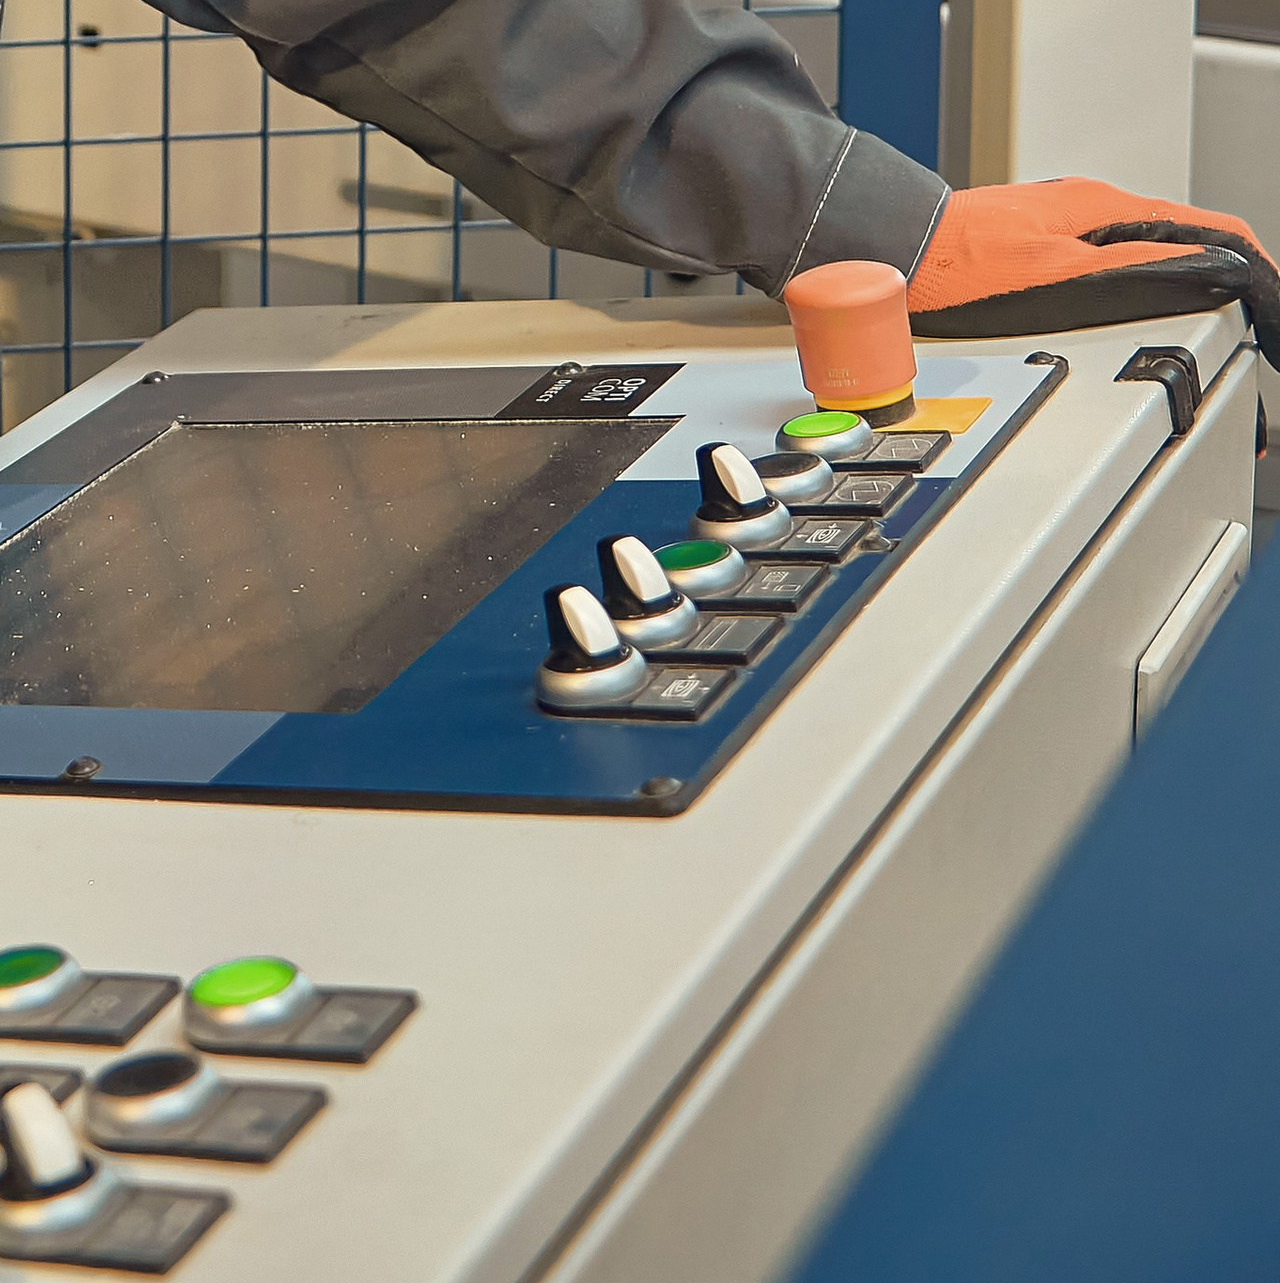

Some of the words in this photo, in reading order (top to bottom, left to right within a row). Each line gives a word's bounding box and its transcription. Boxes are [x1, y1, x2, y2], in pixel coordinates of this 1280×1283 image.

[535, 379, 572, 402] DIRECT
[580, 378, 622, 402] COM
[603, 378, 646, 401] OPTI
